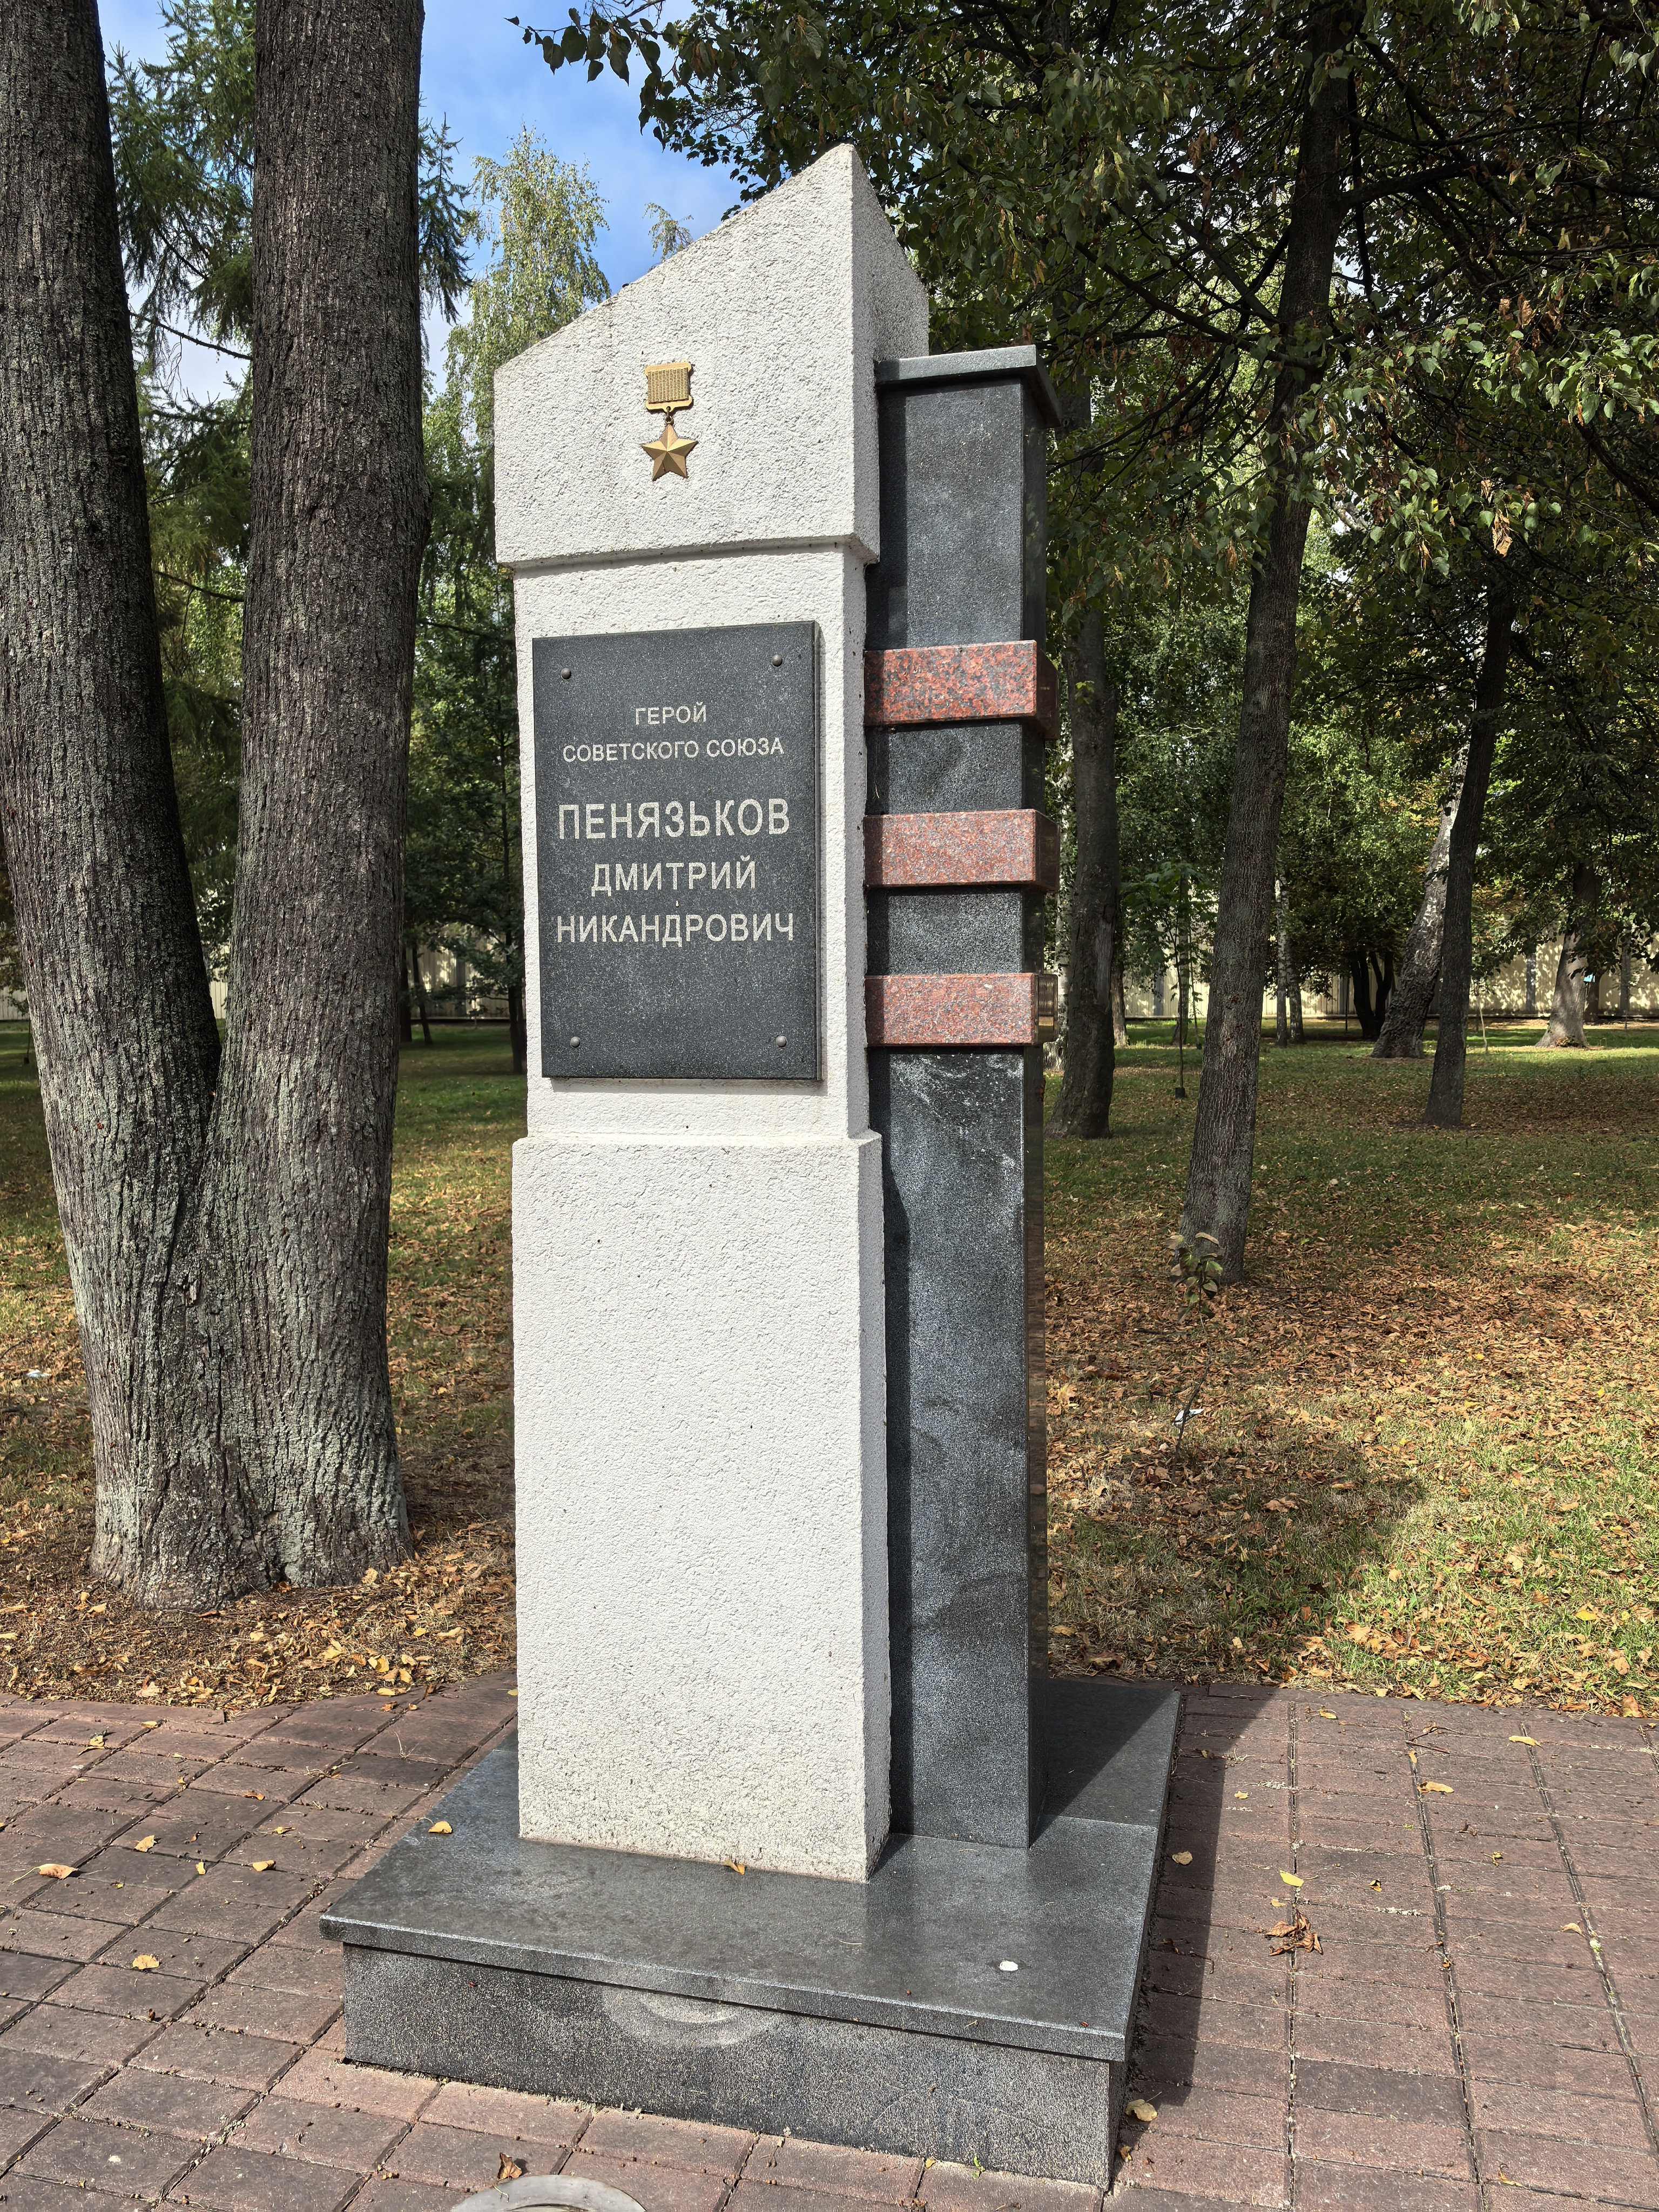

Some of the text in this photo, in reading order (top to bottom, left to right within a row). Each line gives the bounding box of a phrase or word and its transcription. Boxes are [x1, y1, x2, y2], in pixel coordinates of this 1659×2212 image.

[635, 702, 707, 725] ГЕРОЙ
[563, 737, 785, 763] СОВЕТСКОГО СОЮЗА
[558, 798, 790, 840] ПЕНЯЗЬКОВ
[591, 855, 756, 897] ДМИТРИЙ
[557, 913, 794, 948] НИКАНДРОВИЧ
